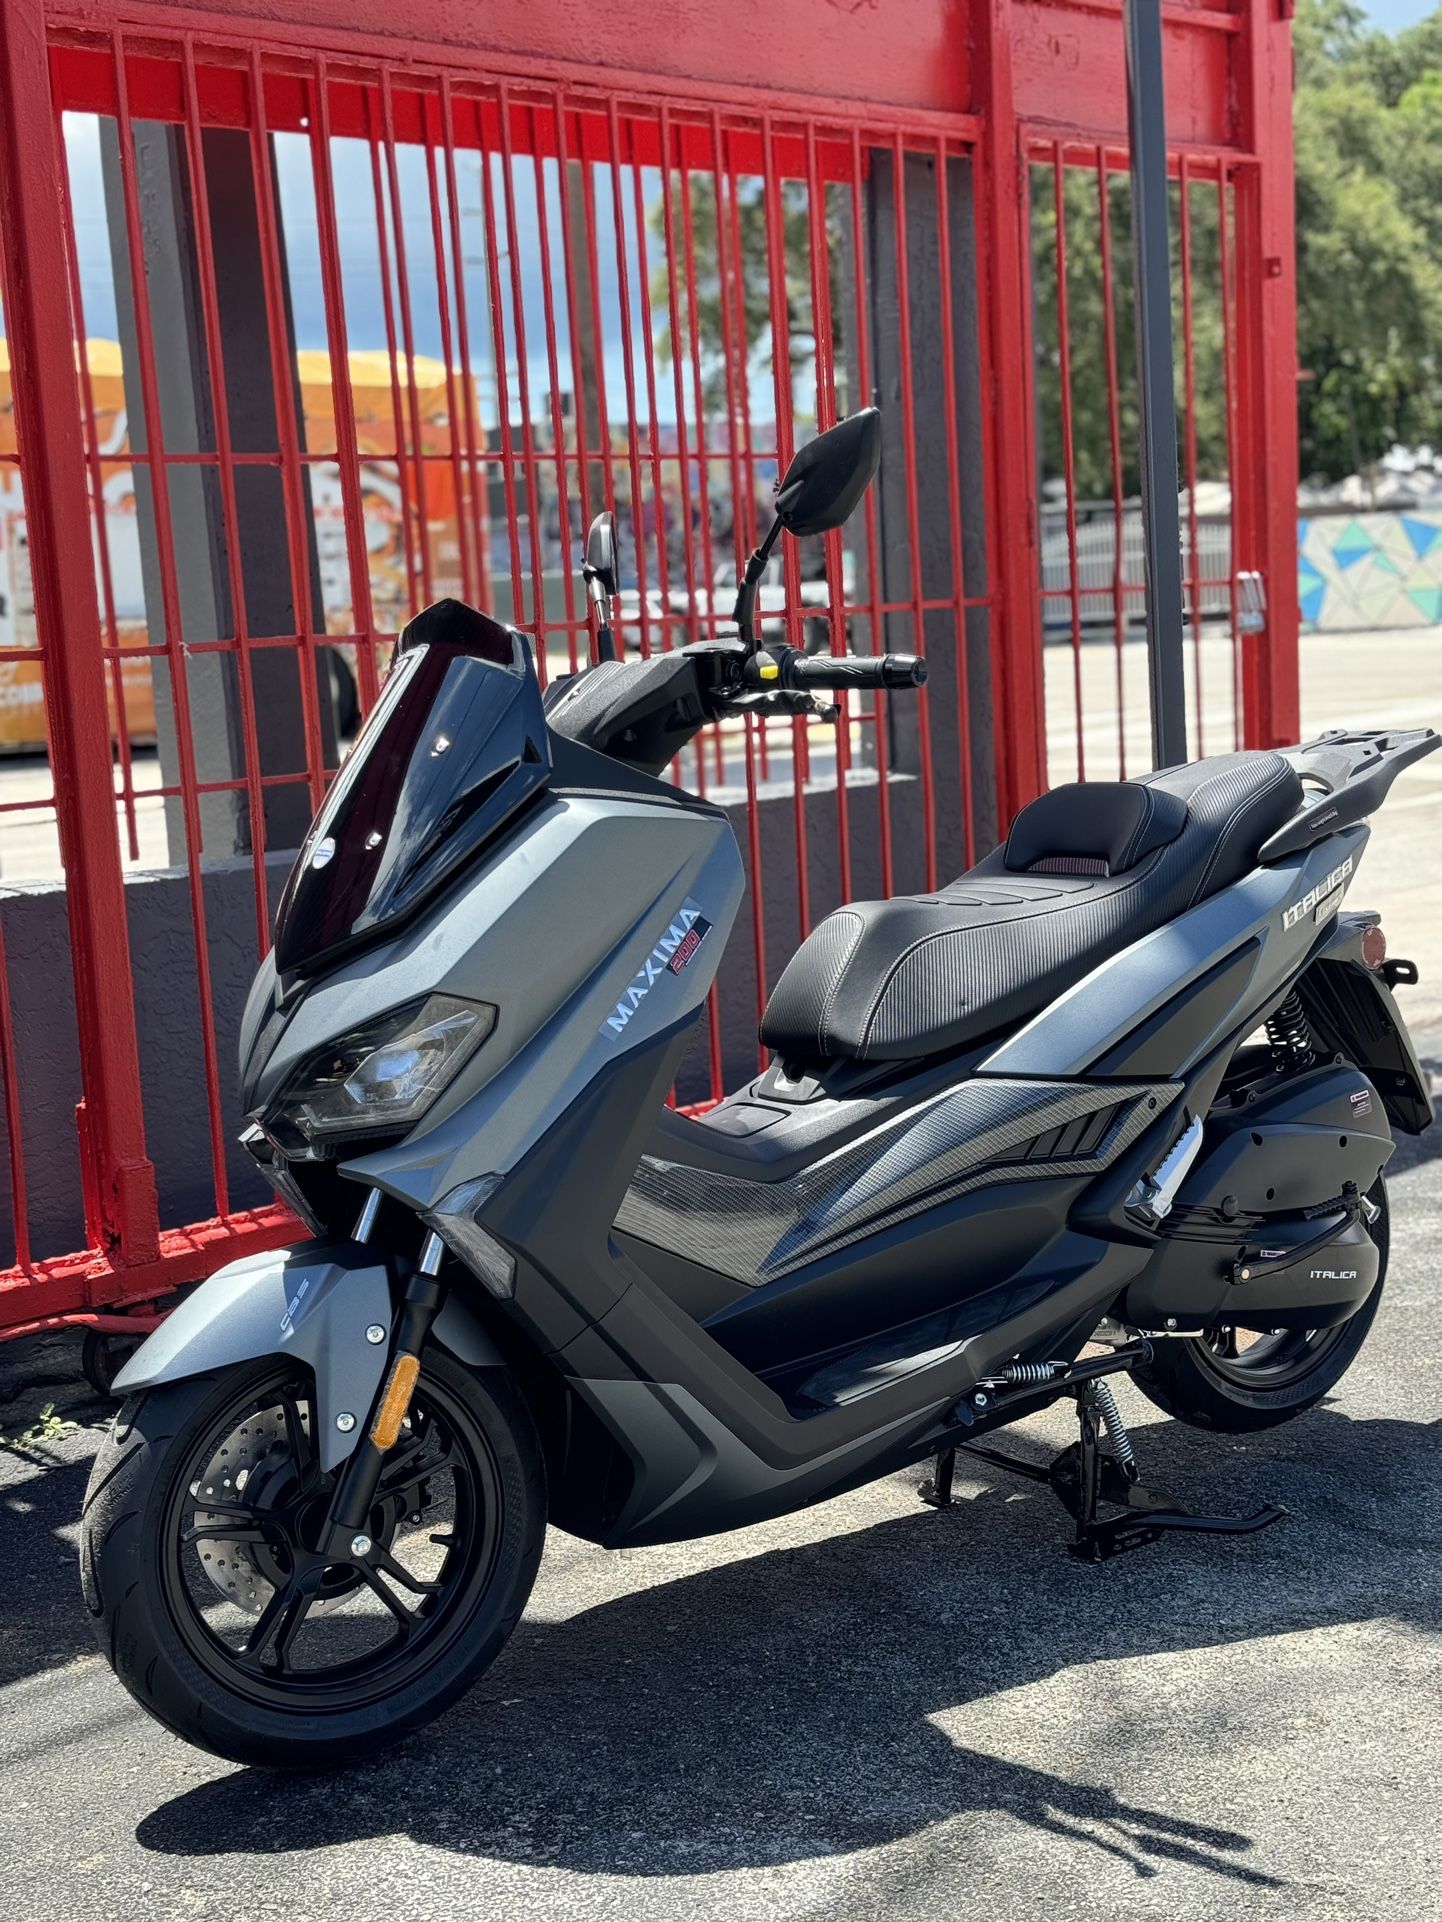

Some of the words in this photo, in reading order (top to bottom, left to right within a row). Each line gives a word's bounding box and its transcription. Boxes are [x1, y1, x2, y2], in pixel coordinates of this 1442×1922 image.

[1282, 854, 1353, 932] ITALICA
[607, 908, 701, 1032] MAXIMA
[670, 929, 700, 975] 200
[1310, 1270, 1357, 1279] ITALICA
[280, 1278, 309, 1331] CBS
